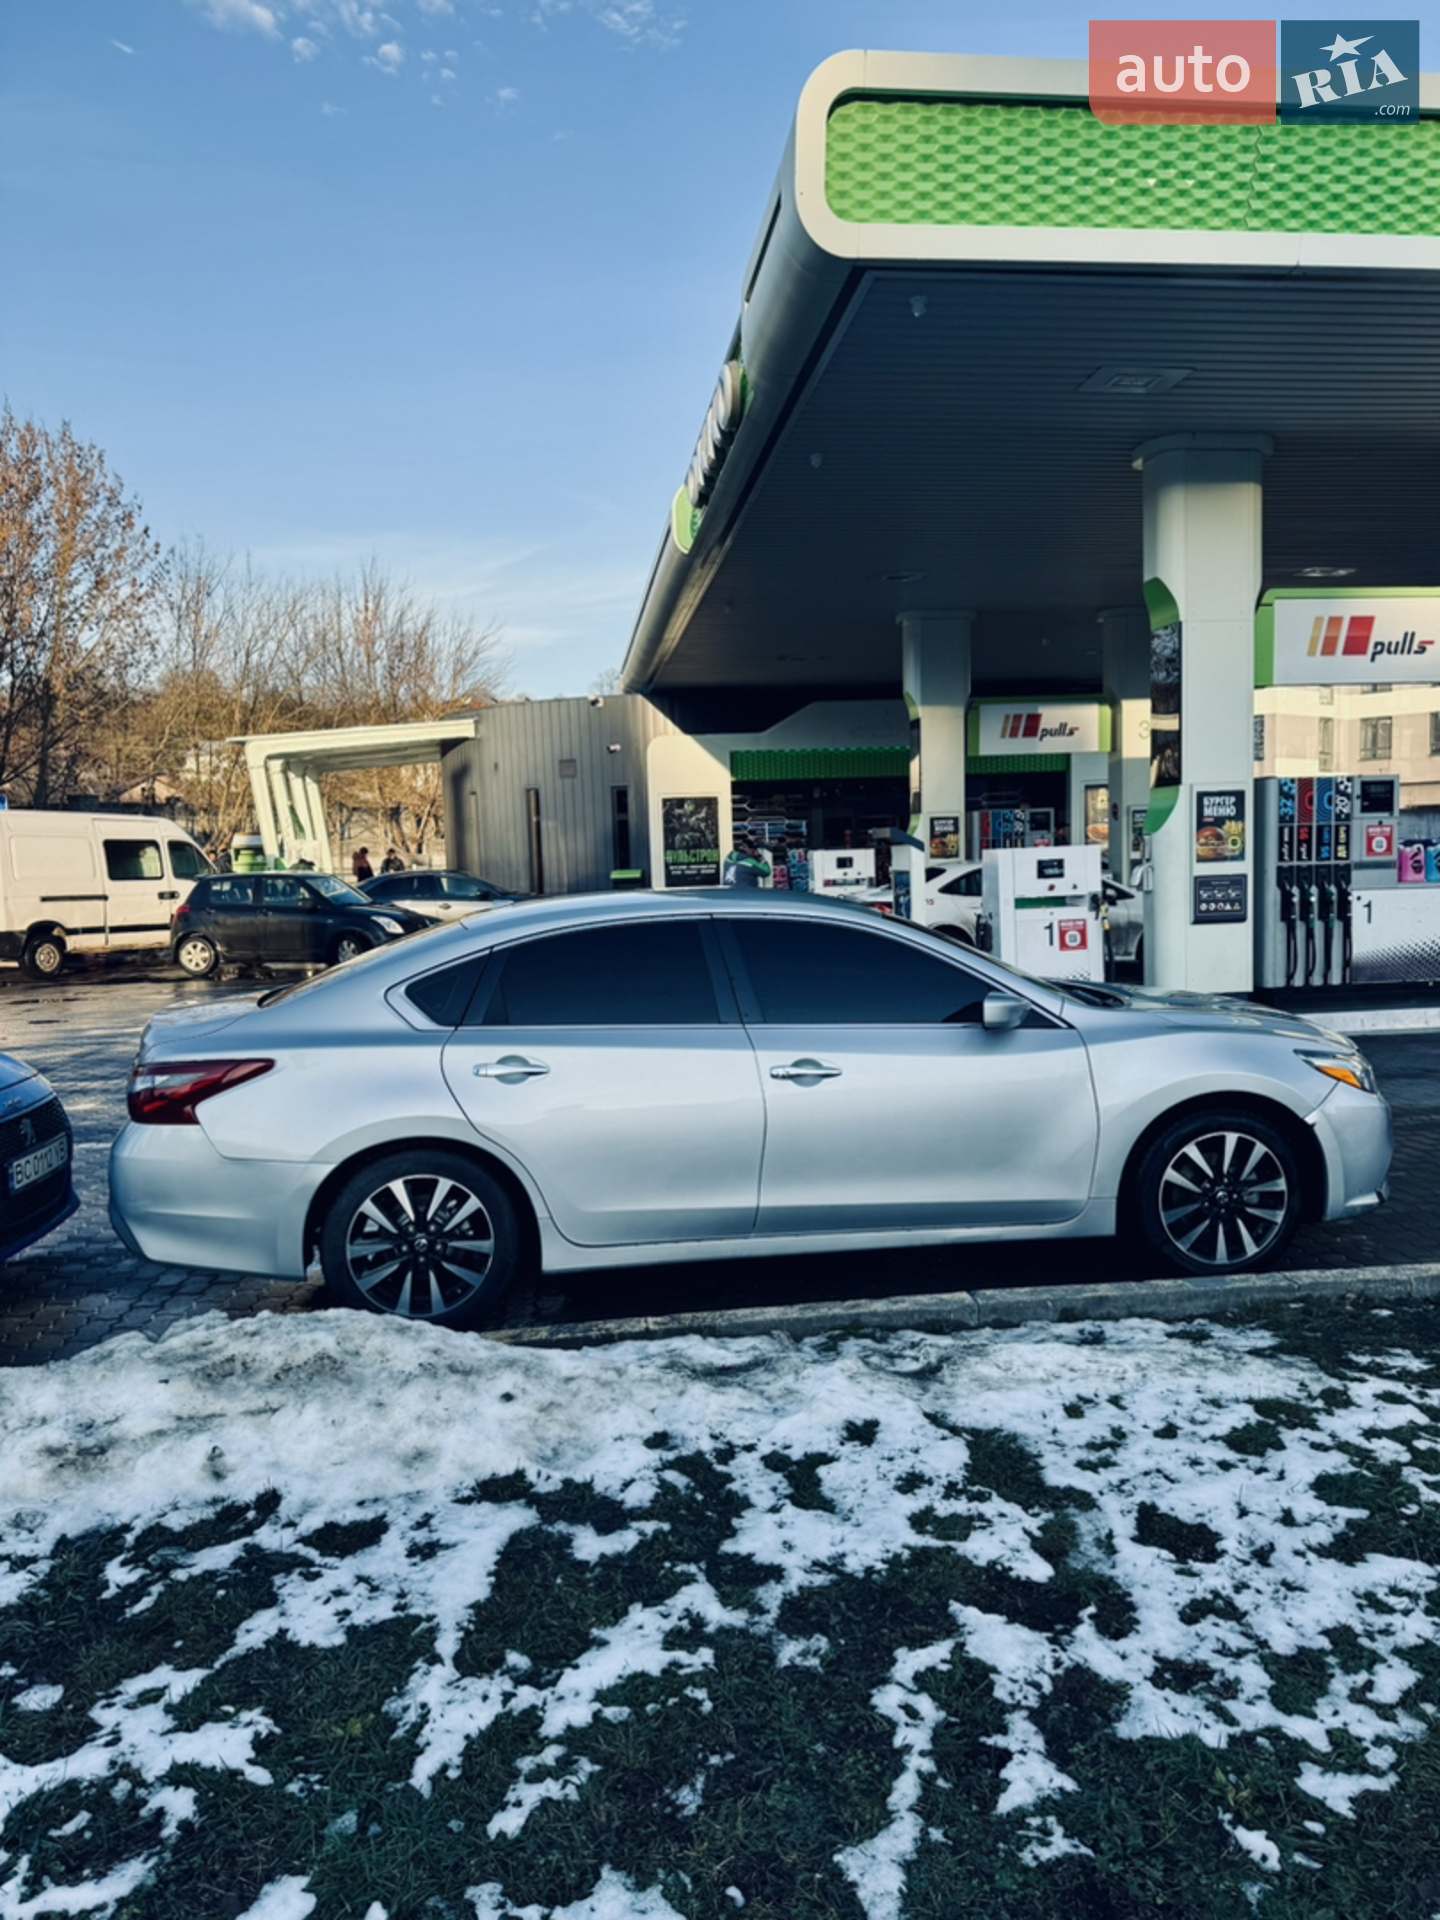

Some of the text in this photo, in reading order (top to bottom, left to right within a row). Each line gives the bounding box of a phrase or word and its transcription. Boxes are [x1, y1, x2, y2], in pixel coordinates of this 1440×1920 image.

[1370, 631, 1435, 663] pulls
[1039, 722, 1079, 742] pulls
[1203, 796, 1236, 807] БУРГЕР
[1203, 805, 1236, 817] МЕНЮ
[1363, 900, 1372, 924] 1
[1044, 922, 1054, 946] 1
[15, 1159, 32, 1185] BC
